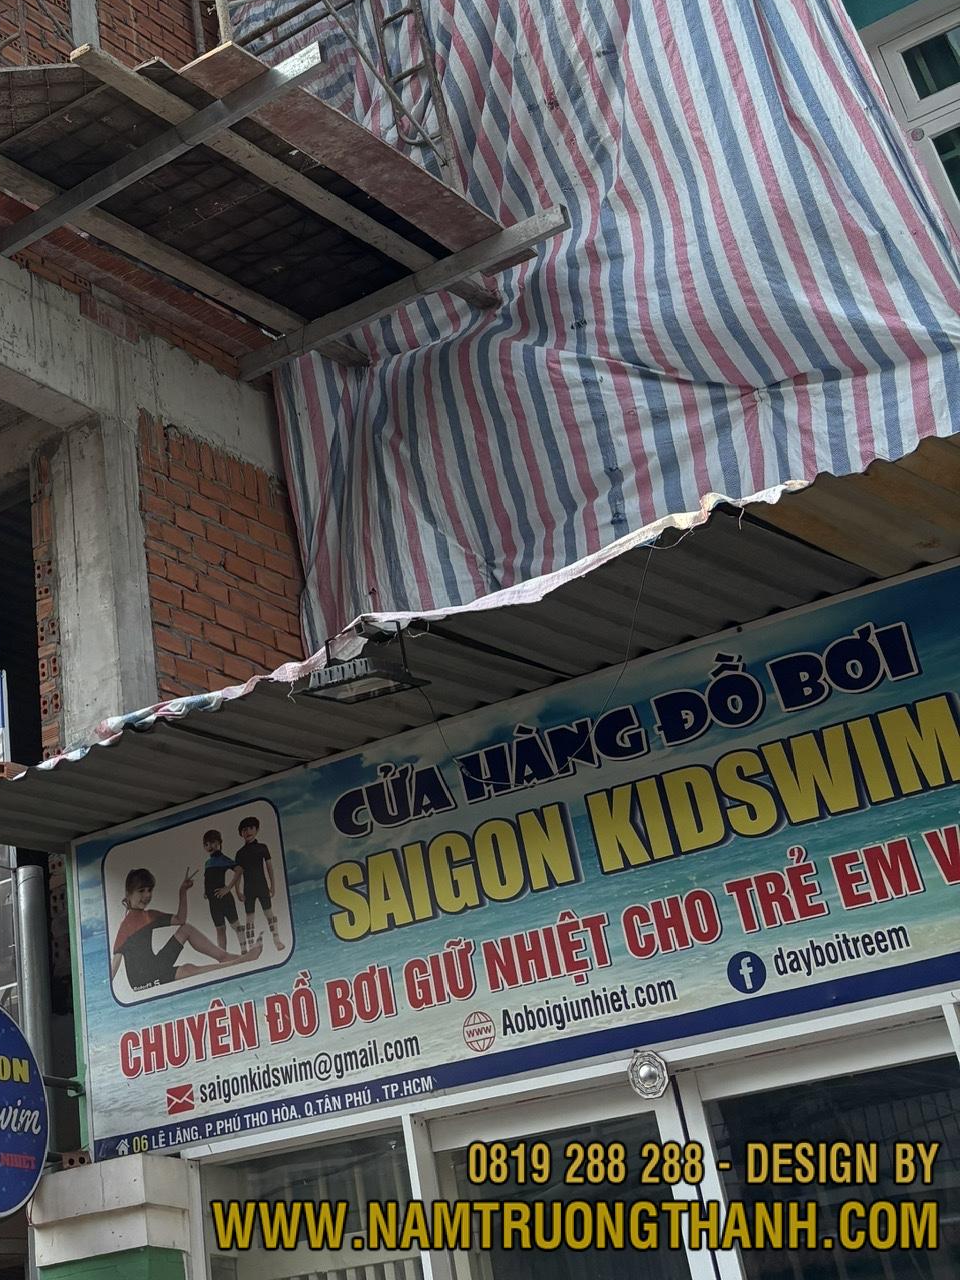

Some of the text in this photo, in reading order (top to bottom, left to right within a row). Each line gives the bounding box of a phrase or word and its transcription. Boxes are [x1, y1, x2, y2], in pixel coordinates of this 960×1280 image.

[330, 620, 925, 837] CỬA HÀNG ĐỒ BƠI
[326, 693, 960, 942] SAIGON KIDSWIM
[119, 998, 259, 1079] CHUYÊN
[264, 970, 319, 1044] ĐỒ
[326, 963, 397, 1031] BƠI
[403, 937, 477, 1010] GIỮ
[481, 910, 611, 993] NHIỆT
[621, 887, 721, 960] CHO
[724, 846, 828, 934] TRẺ
[830, 837, 924, 911] EM
[774, 924, 911, 978] dayboitreem
[501, 978, 677, 1037] Aoboigiunhiet.com
[199, 1034, 421, 1105] saigonkidswim@gmail.com
[132, 1135, 149, 1153] 06
[205, 1113, 241, 1137] P.PHÚ
[304, 1094, 341, 1117] Q.TÂN
[345, 1086, 372, 1108] PHÚ
[382, 1075, 433, 1100] TP.HCM
